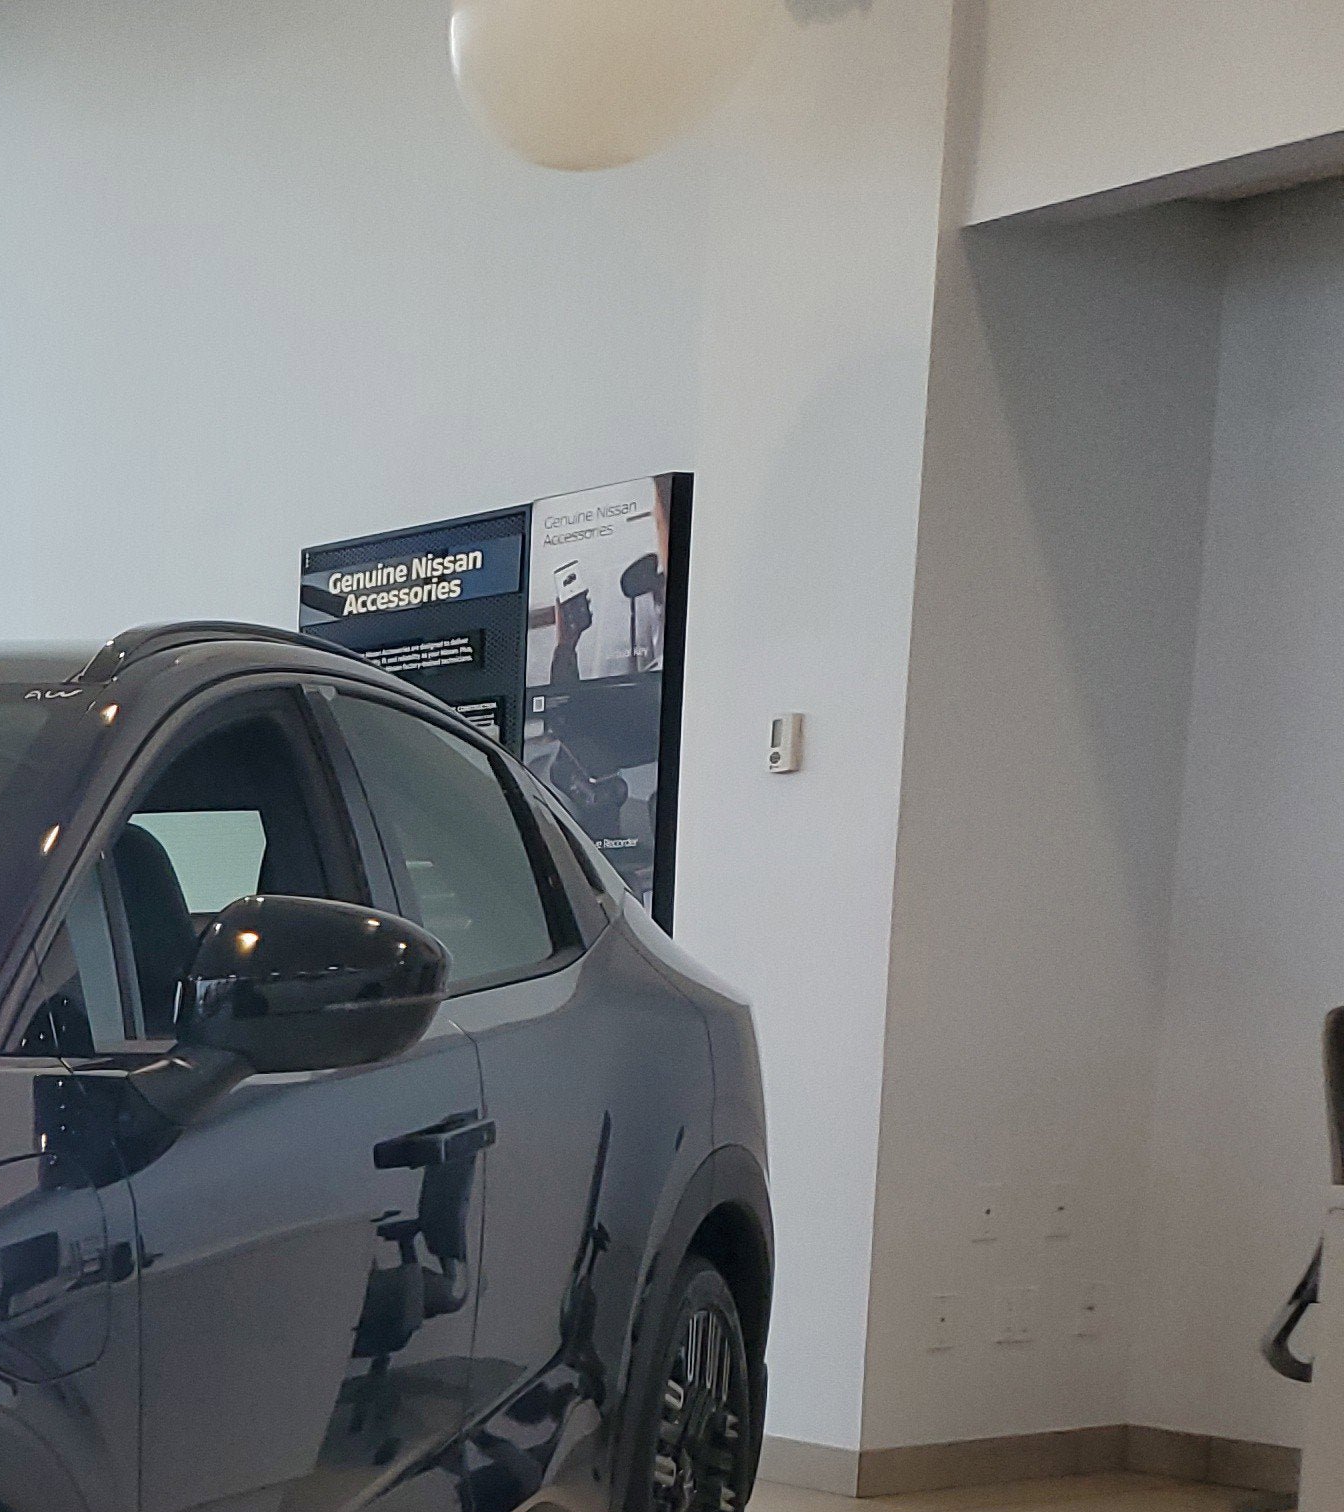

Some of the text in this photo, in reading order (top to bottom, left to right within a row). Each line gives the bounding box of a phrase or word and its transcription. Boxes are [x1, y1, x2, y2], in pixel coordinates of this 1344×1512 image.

[544, 501, 637, 530] Genuine Nissan
[543, 524, 614, 547] Accessories
[328, 550, 483, 595] Genuine Nissan
[342, 578, 462, 616] Accessories
